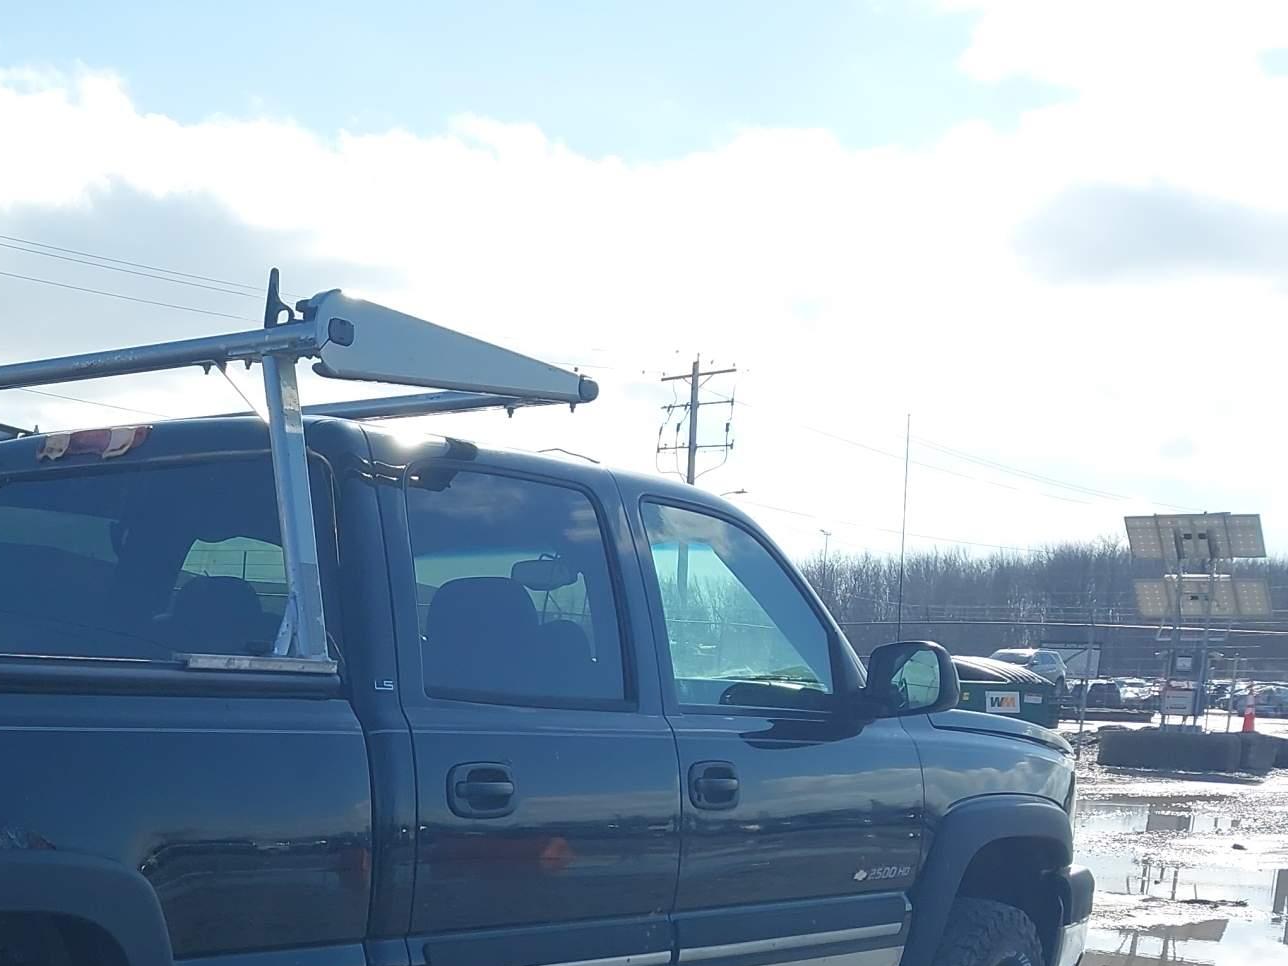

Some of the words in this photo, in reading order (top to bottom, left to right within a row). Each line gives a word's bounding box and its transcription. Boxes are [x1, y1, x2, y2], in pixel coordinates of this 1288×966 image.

[374, 679, 394, 691] LS
[990, 696, 1017, 708] WM
[869, 866, 898, 880] 2500
